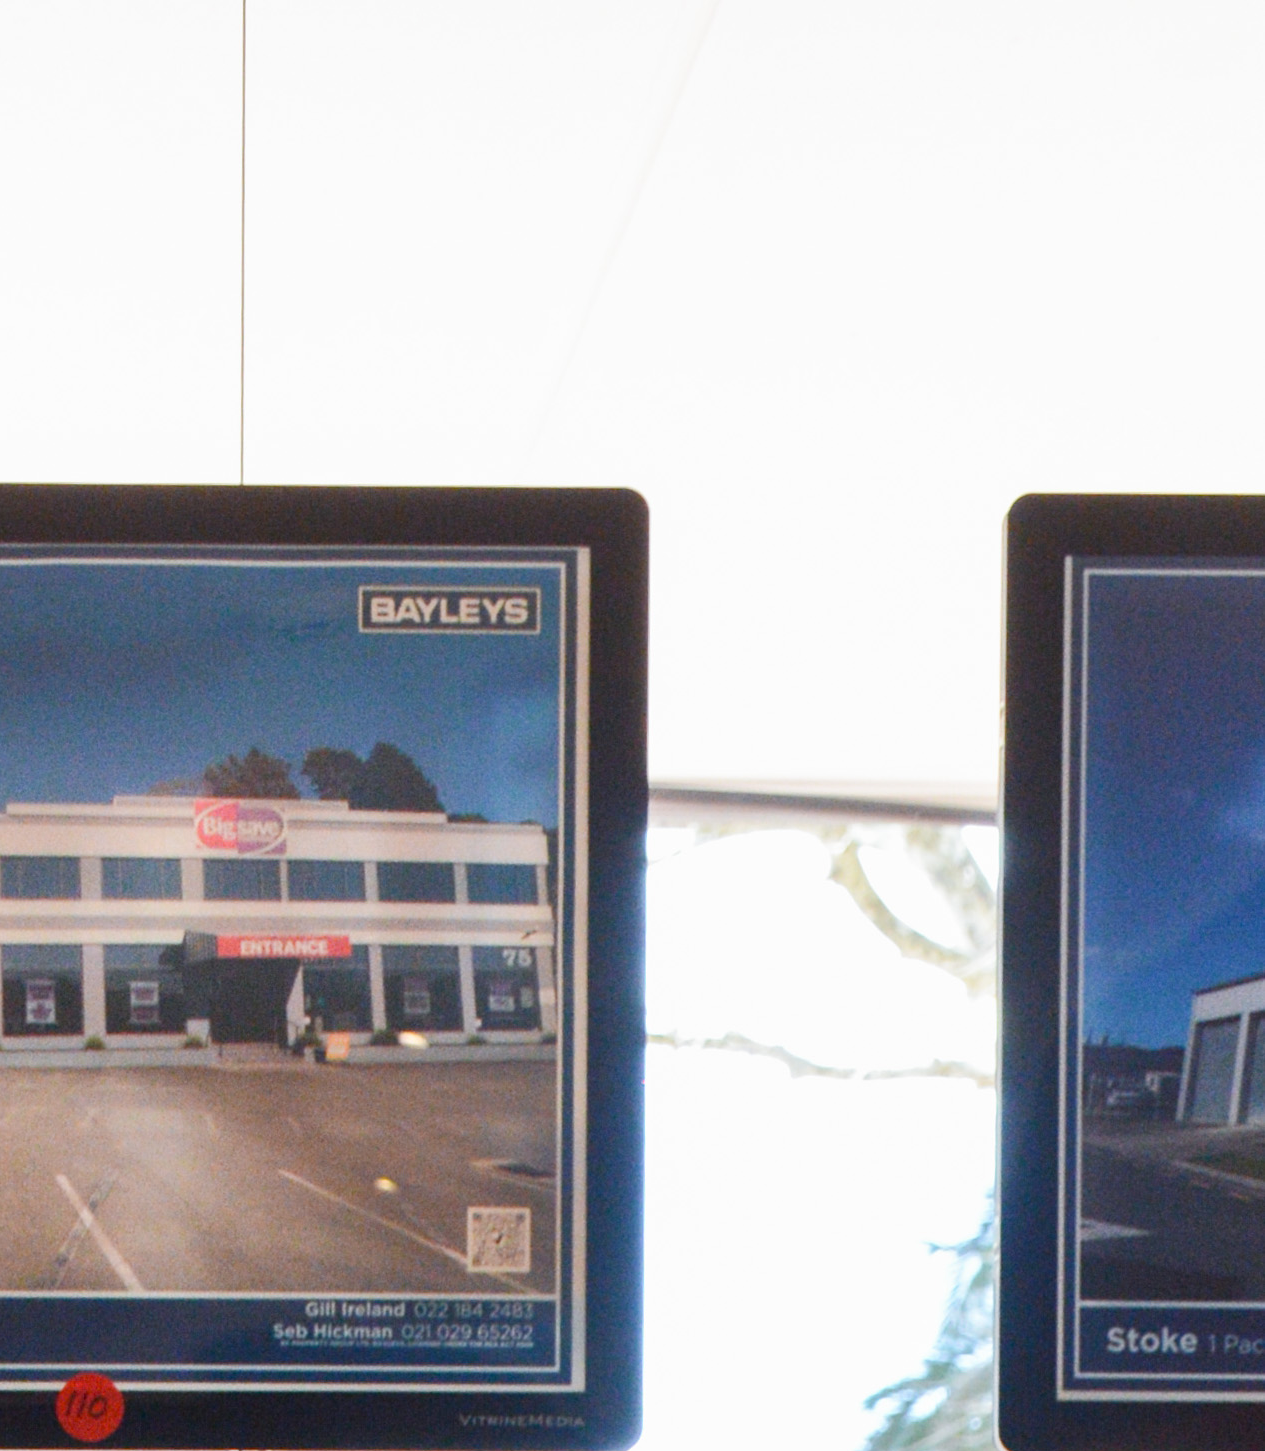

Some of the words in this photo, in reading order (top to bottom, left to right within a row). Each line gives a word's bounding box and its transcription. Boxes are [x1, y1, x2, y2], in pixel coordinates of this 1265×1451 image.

[370, 596, 528, 624] BAYLEYS
[202, 816, 238, 841] Big
[239, 939, 329, 956] ENTRANCE
[501, 948, 533, 968] 75
[305, 1302, 337, 1318] Gill
[342, 1301, 406, 1318] Ireland
[414, 1303, 449, 1319] 022
[454, 1303, 483, 1319] 184
[489, 1303, 534, 1319] 2483
[273, 1323, 308, 1340] Seb
[314, 1323, 393, 1339] Hickman
[401, 1324, 432, 1340] 021
[437, 1324, 472, 1340] 029
[478, 1324, 534, 1340] 65262
[1106, 1326, 1199, 1353] Stoke
[1207, 1334, 1216, 1354] 1
